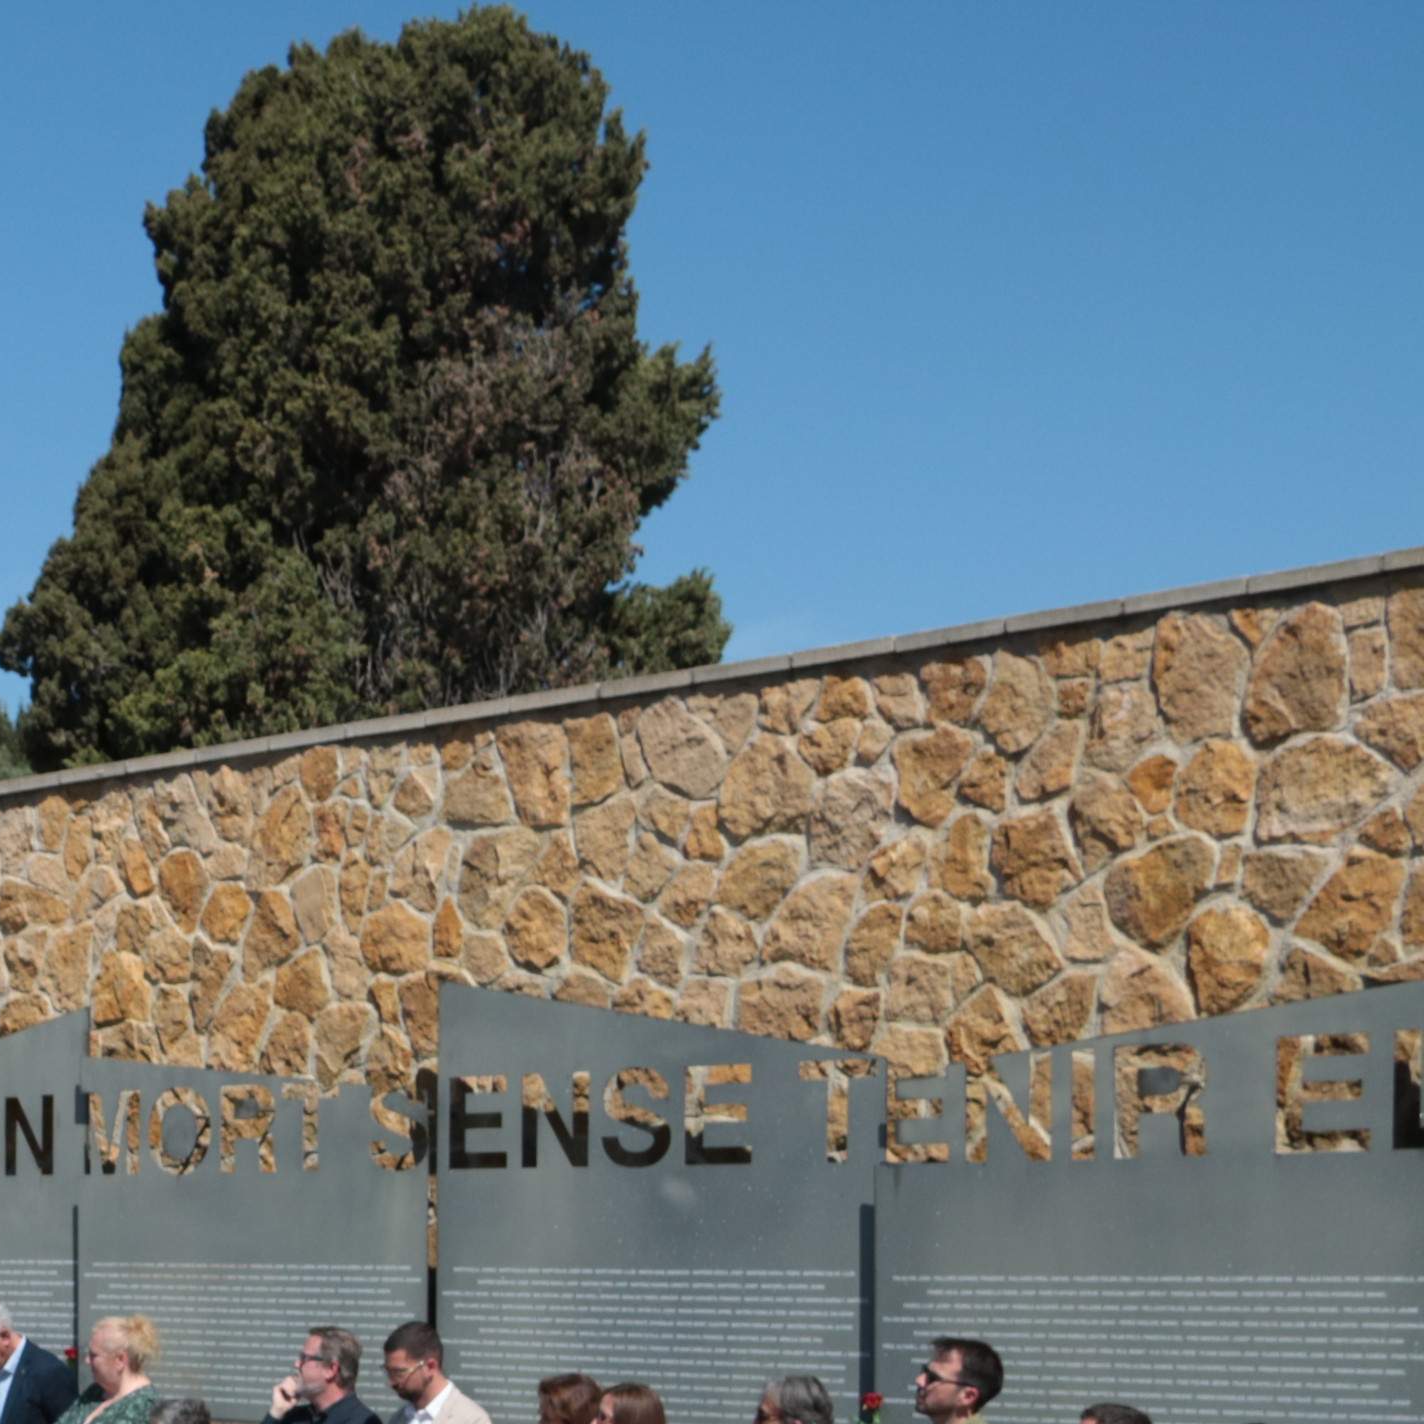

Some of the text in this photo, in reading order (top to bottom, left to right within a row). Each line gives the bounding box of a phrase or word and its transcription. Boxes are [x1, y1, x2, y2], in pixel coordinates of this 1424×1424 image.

[83, 1081, 340, 1175] MORT
[369, 1063, 752, 1171] SENSE
[799, 1042, 1207, 1164] TENIR
